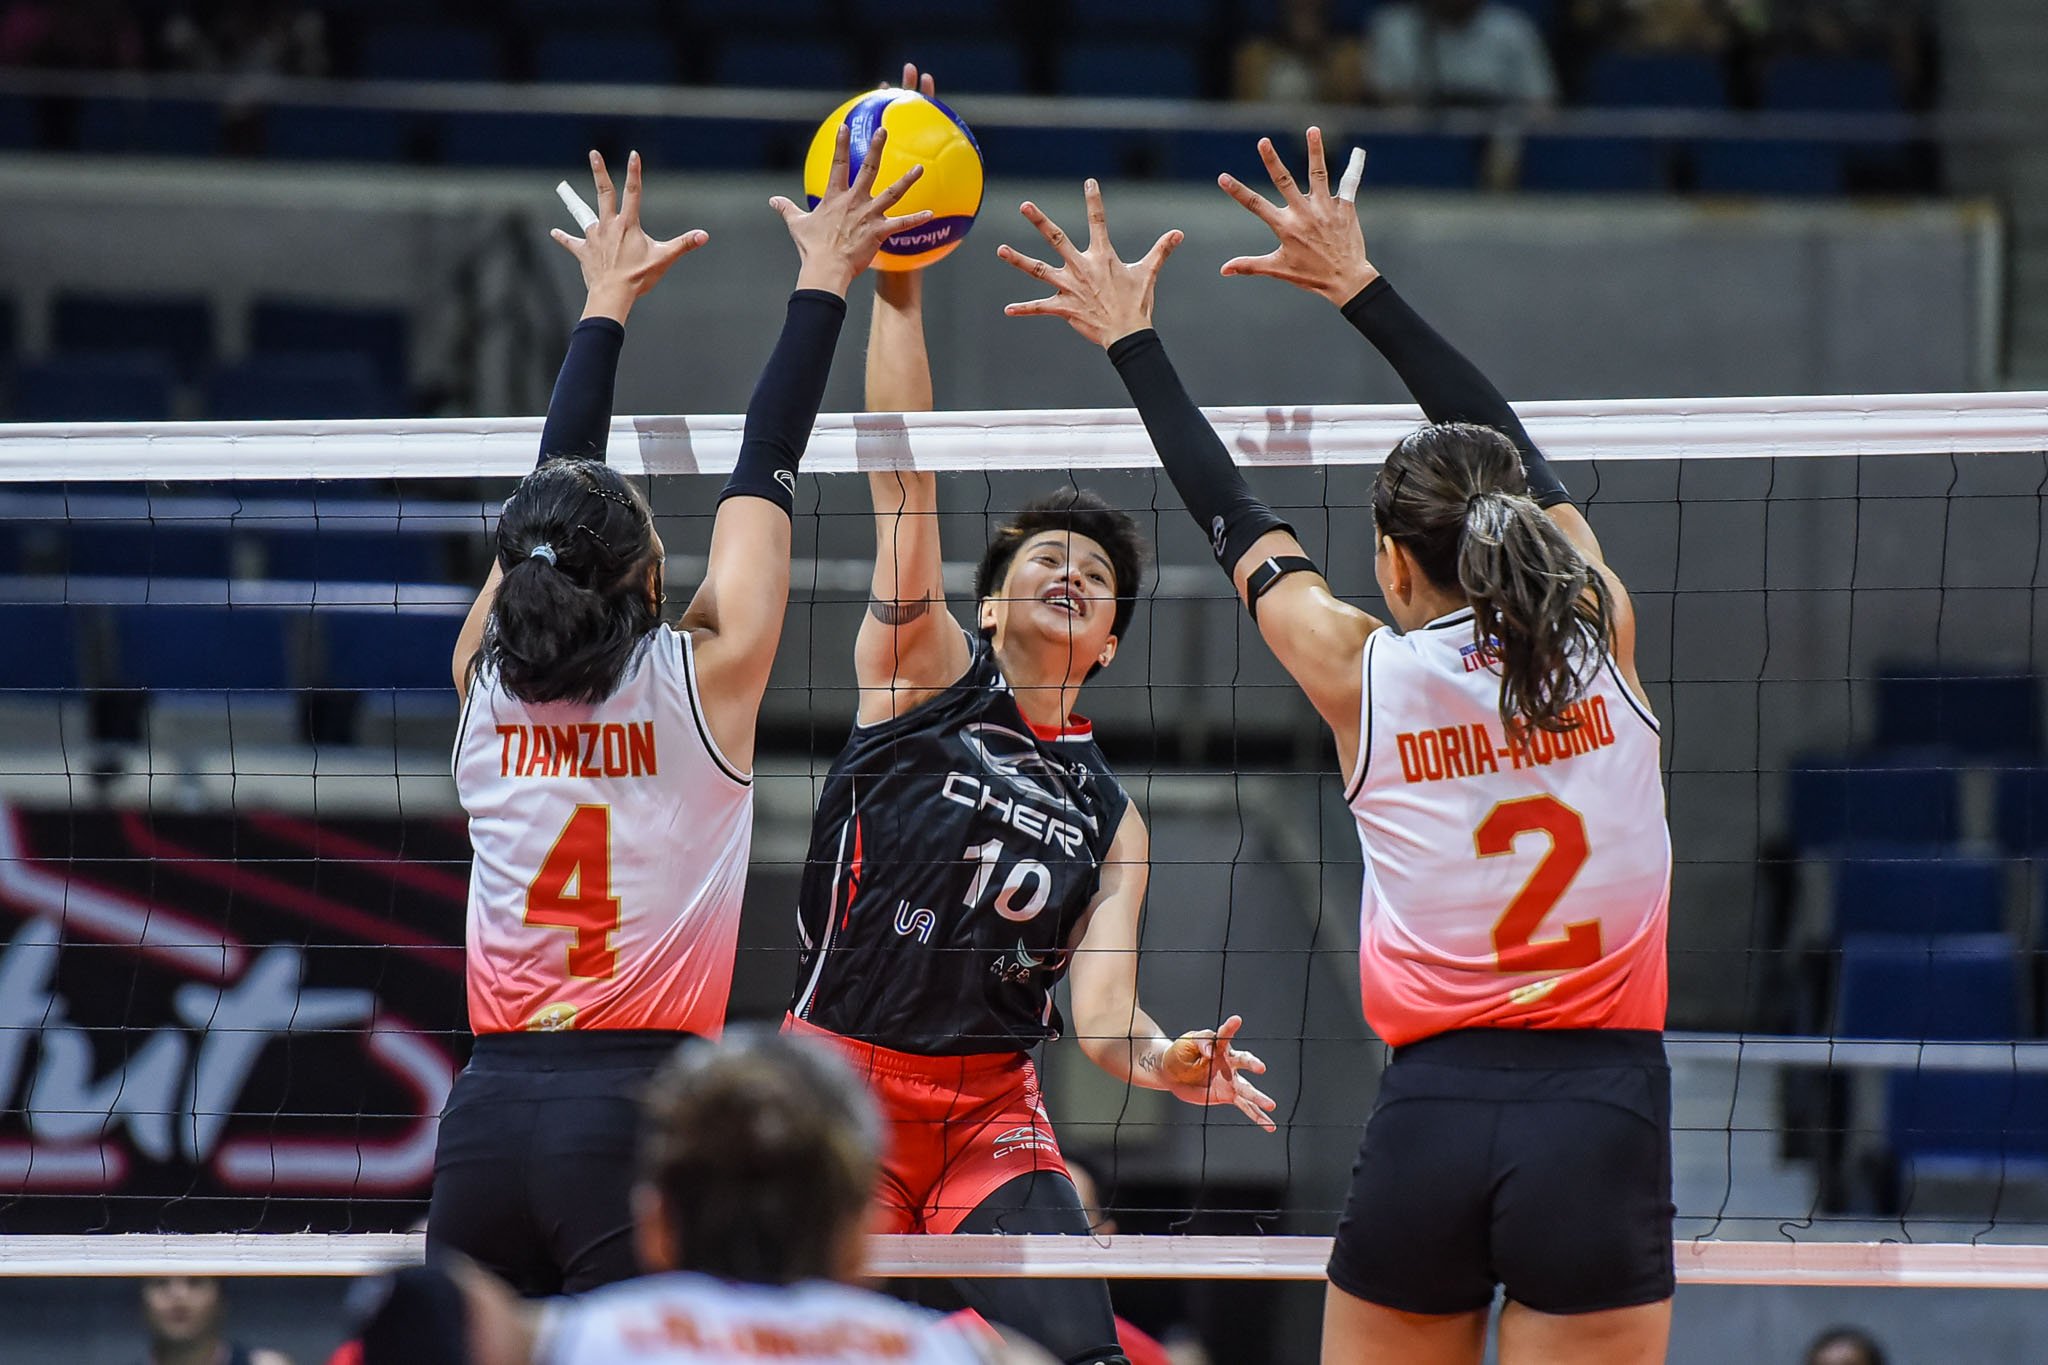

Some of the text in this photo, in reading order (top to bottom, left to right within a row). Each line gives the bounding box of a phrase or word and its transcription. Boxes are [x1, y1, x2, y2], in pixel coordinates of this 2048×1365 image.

[496, 720, 658, 778] TIAMZON
[523, 804, 621, 979] 4
[962, 838, 1052, 922] 10
[1473, 793, 1605, 974] 2
